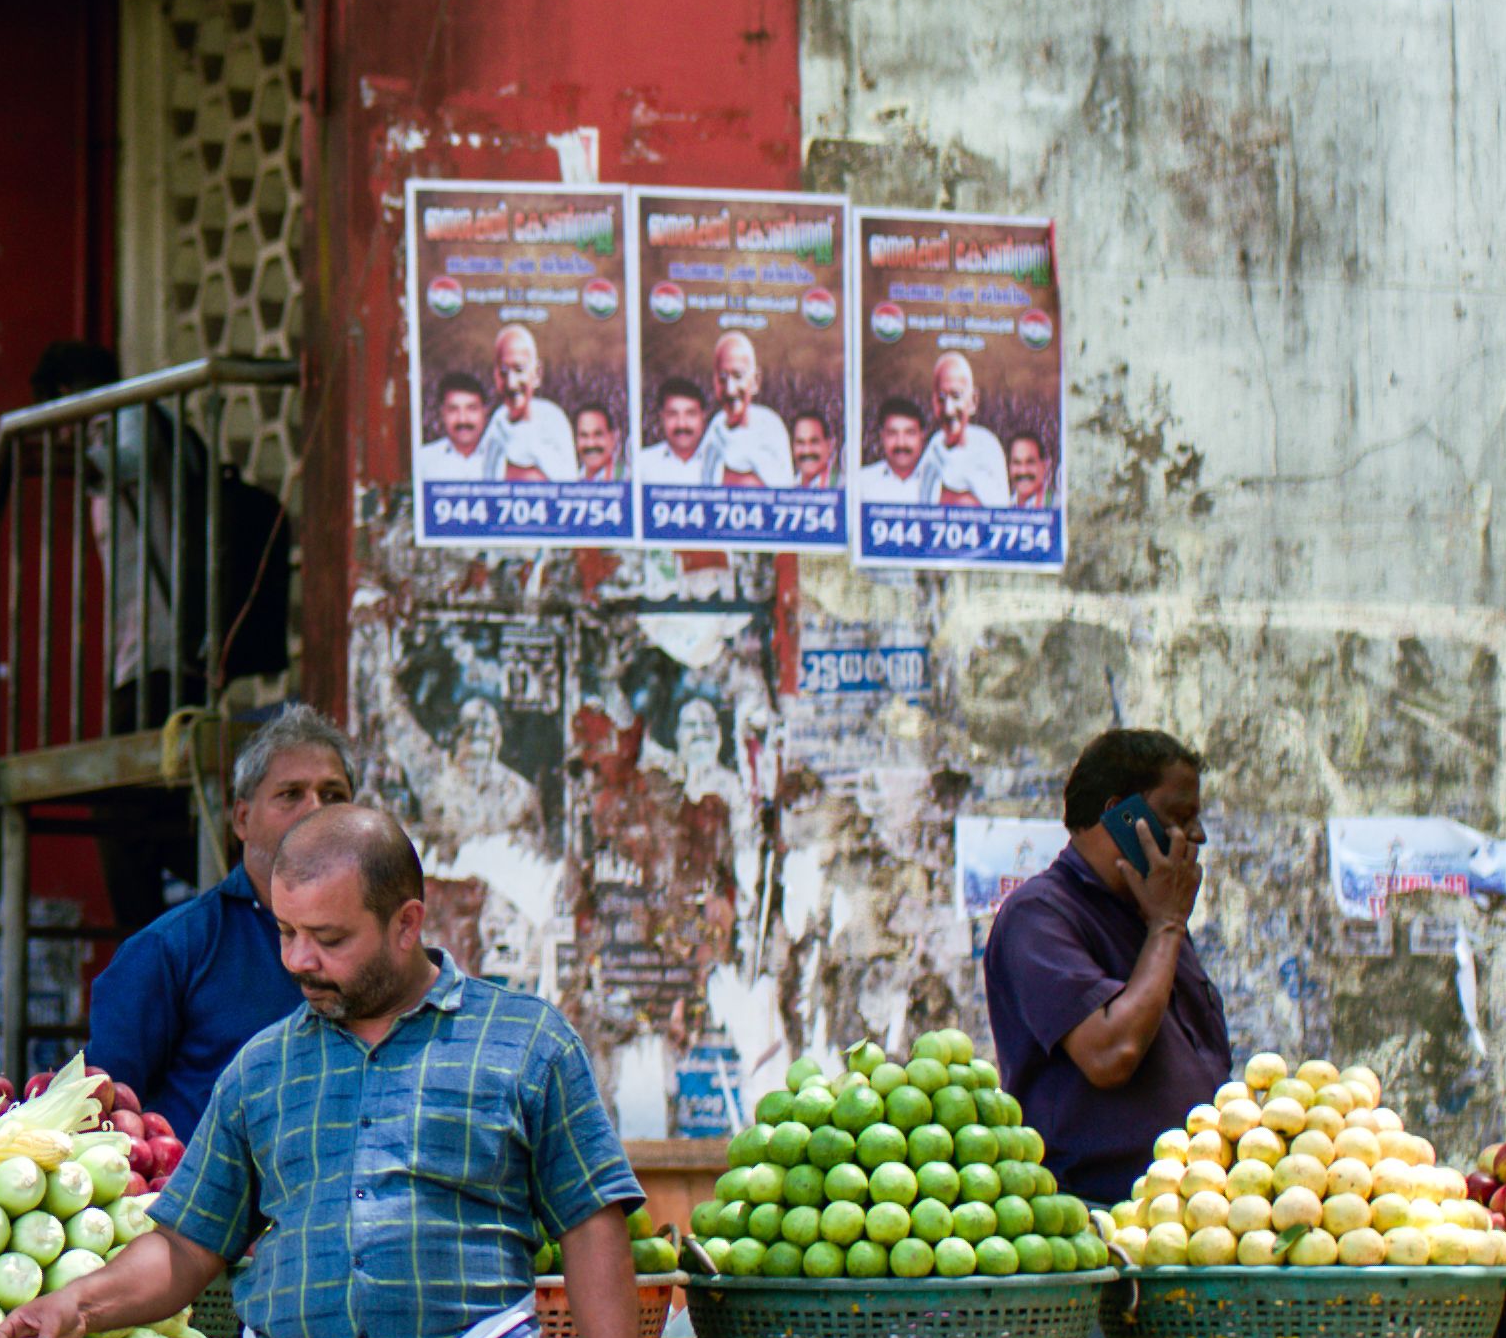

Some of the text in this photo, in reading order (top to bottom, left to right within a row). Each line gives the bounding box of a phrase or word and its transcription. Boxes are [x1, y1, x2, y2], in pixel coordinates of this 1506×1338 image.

[433, 497, 622, 527] 944 704 7754
[651, 501, 705, 529] 944
[713, 502, 764, 531] 704
[772, 504, 837, 534] 7754
[870, 519, 1051, 553] 944 704 7754
